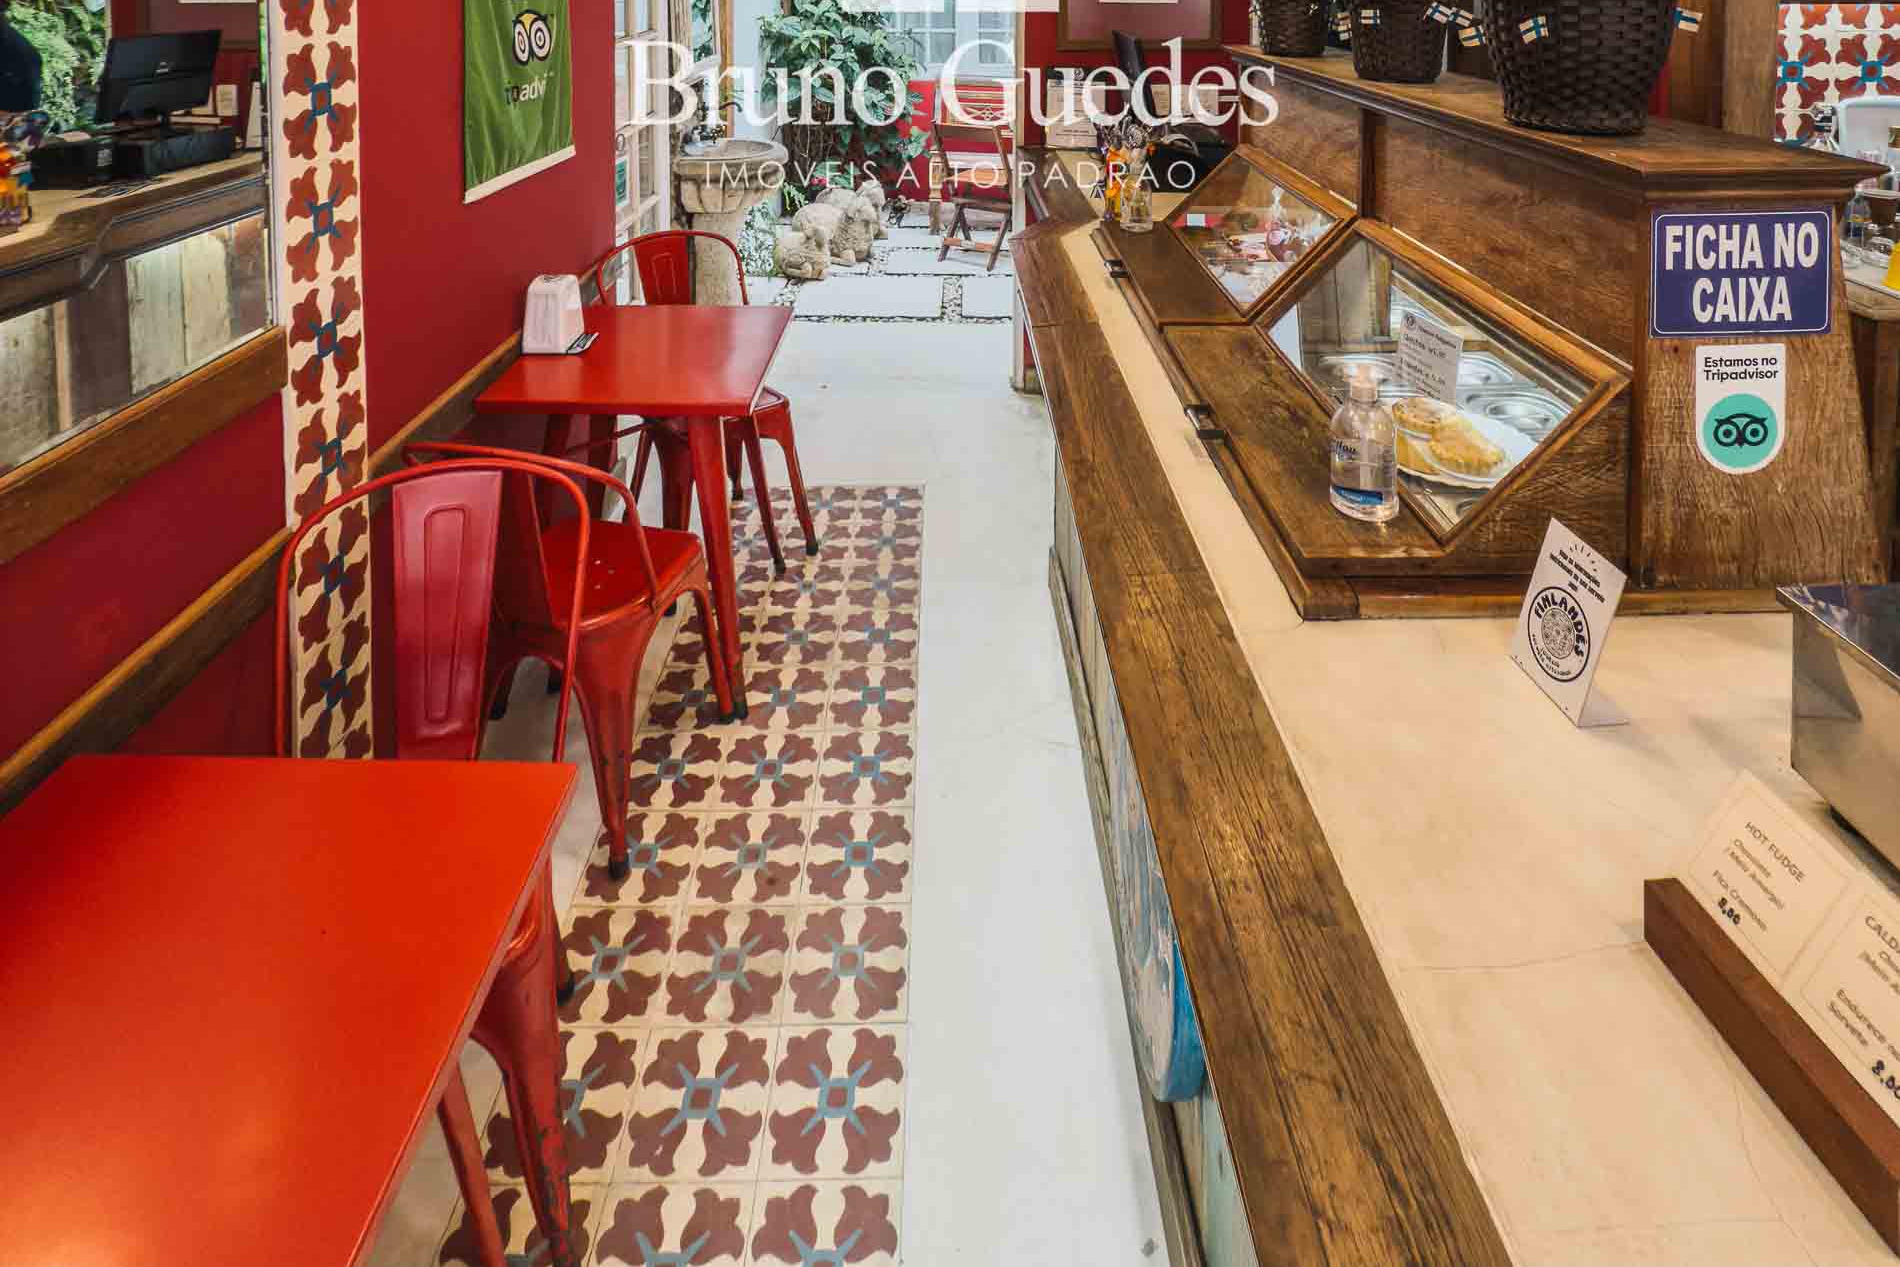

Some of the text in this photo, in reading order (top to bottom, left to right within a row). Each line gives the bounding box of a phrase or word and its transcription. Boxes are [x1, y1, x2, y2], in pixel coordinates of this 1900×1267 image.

[1665, 222, 1820, 270] FICHA NO
[1692, 276, 1793, 323] CAIXA
[1703, 356, 1778, 368] Estamos no
[1703, 368, 1779, 383] Tripadvisor
[1744, 821, 1769, 845] HOT
[1768, 843, 1807, 883] FUDGE
